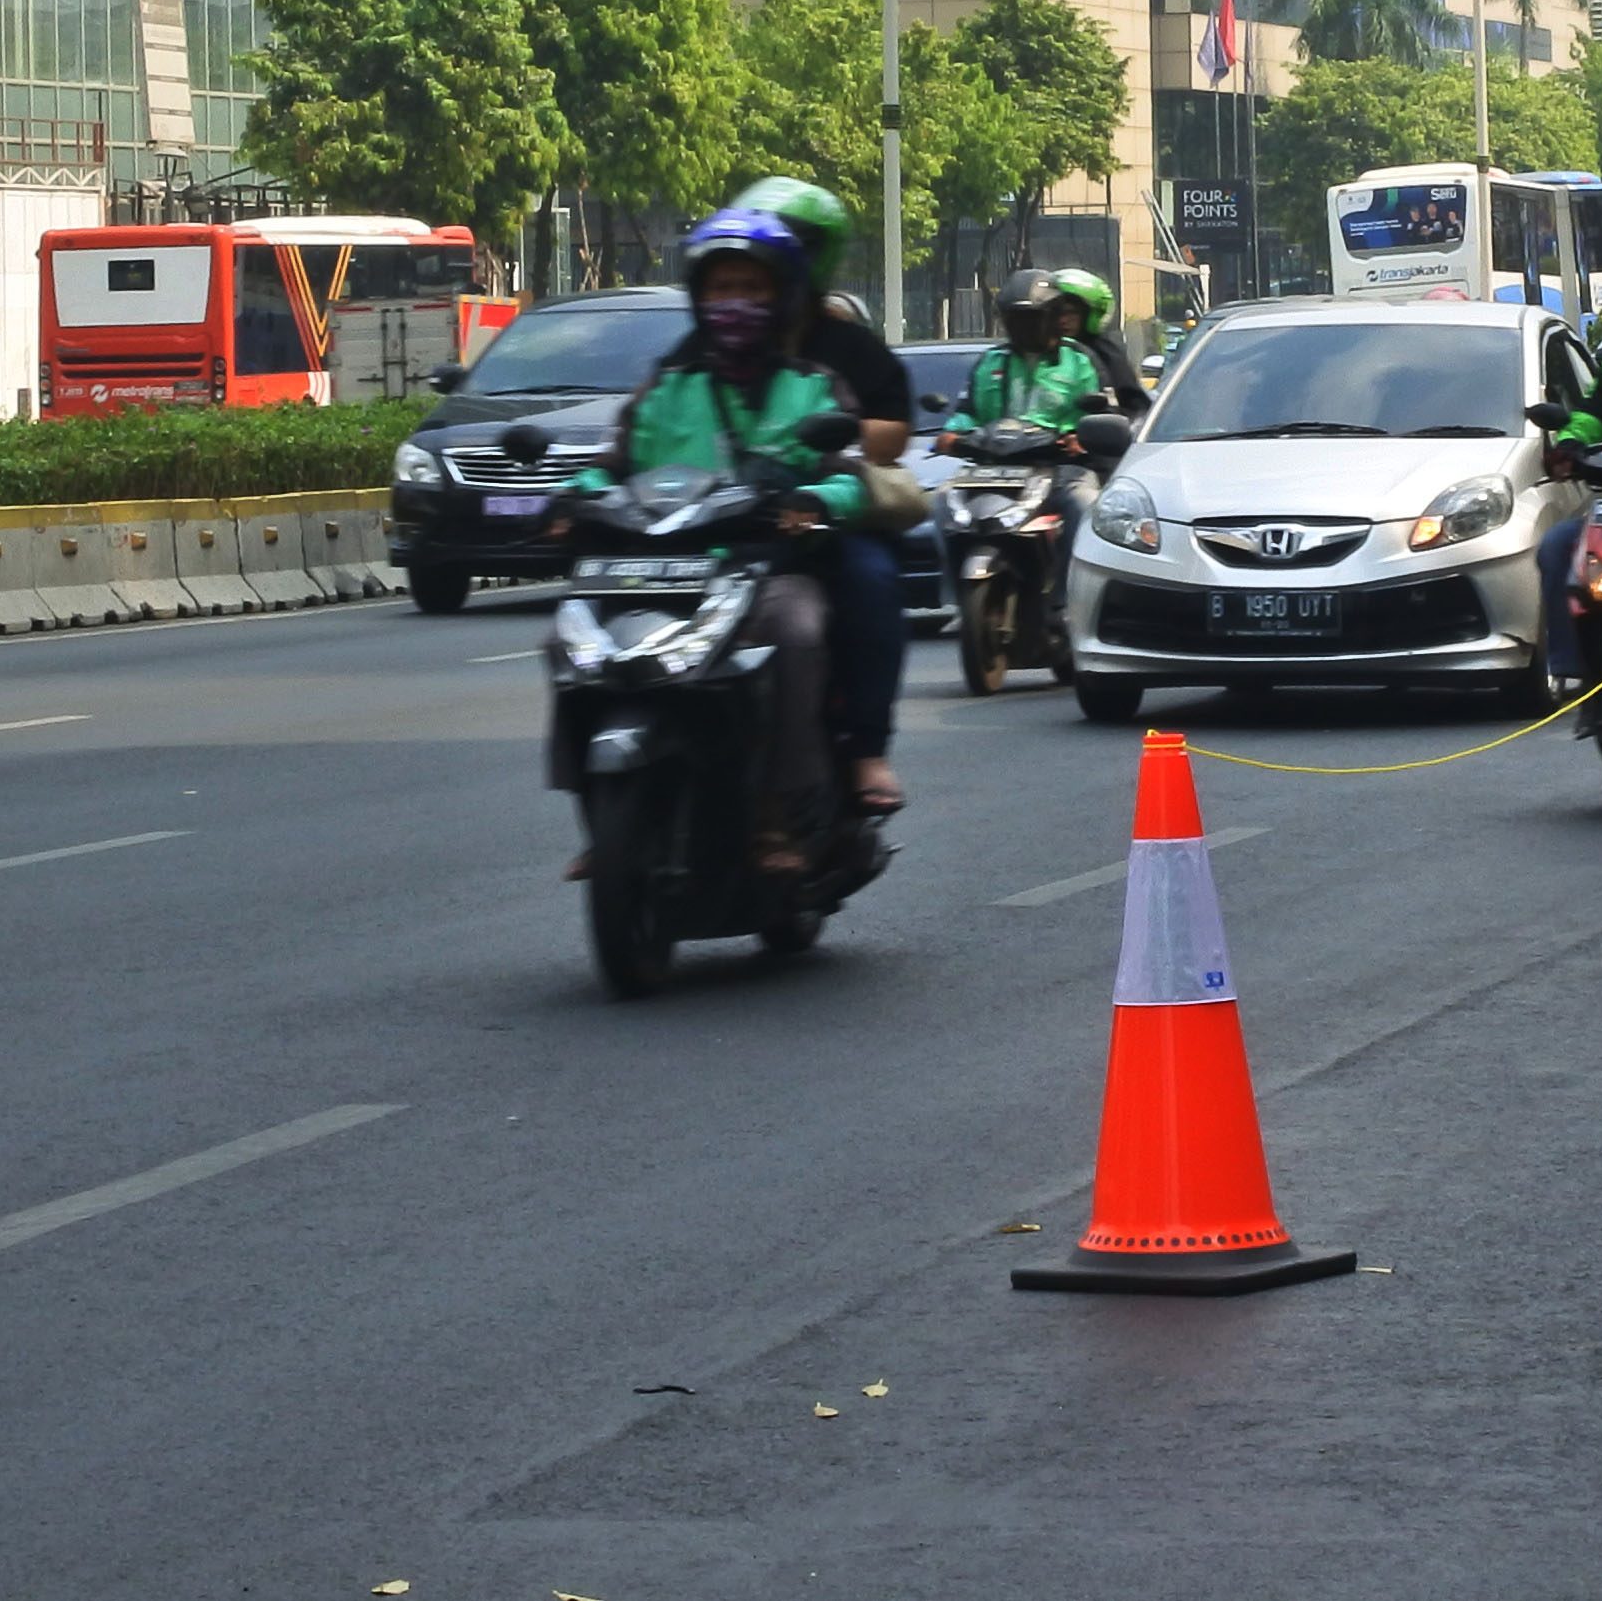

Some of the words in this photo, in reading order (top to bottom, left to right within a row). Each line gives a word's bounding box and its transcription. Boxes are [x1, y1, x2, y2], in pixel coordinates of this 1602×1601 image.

[1183, 189, 1223, 203] FOUR
[1183, 204, 1237, 218] POINTS
[1380, 265, 1449, 280] transjakarta
[111, 385, 174, 399] metrotrans
[1212, 595, 1224, 617] B
[1300, 595, 1333, 616] UYT
